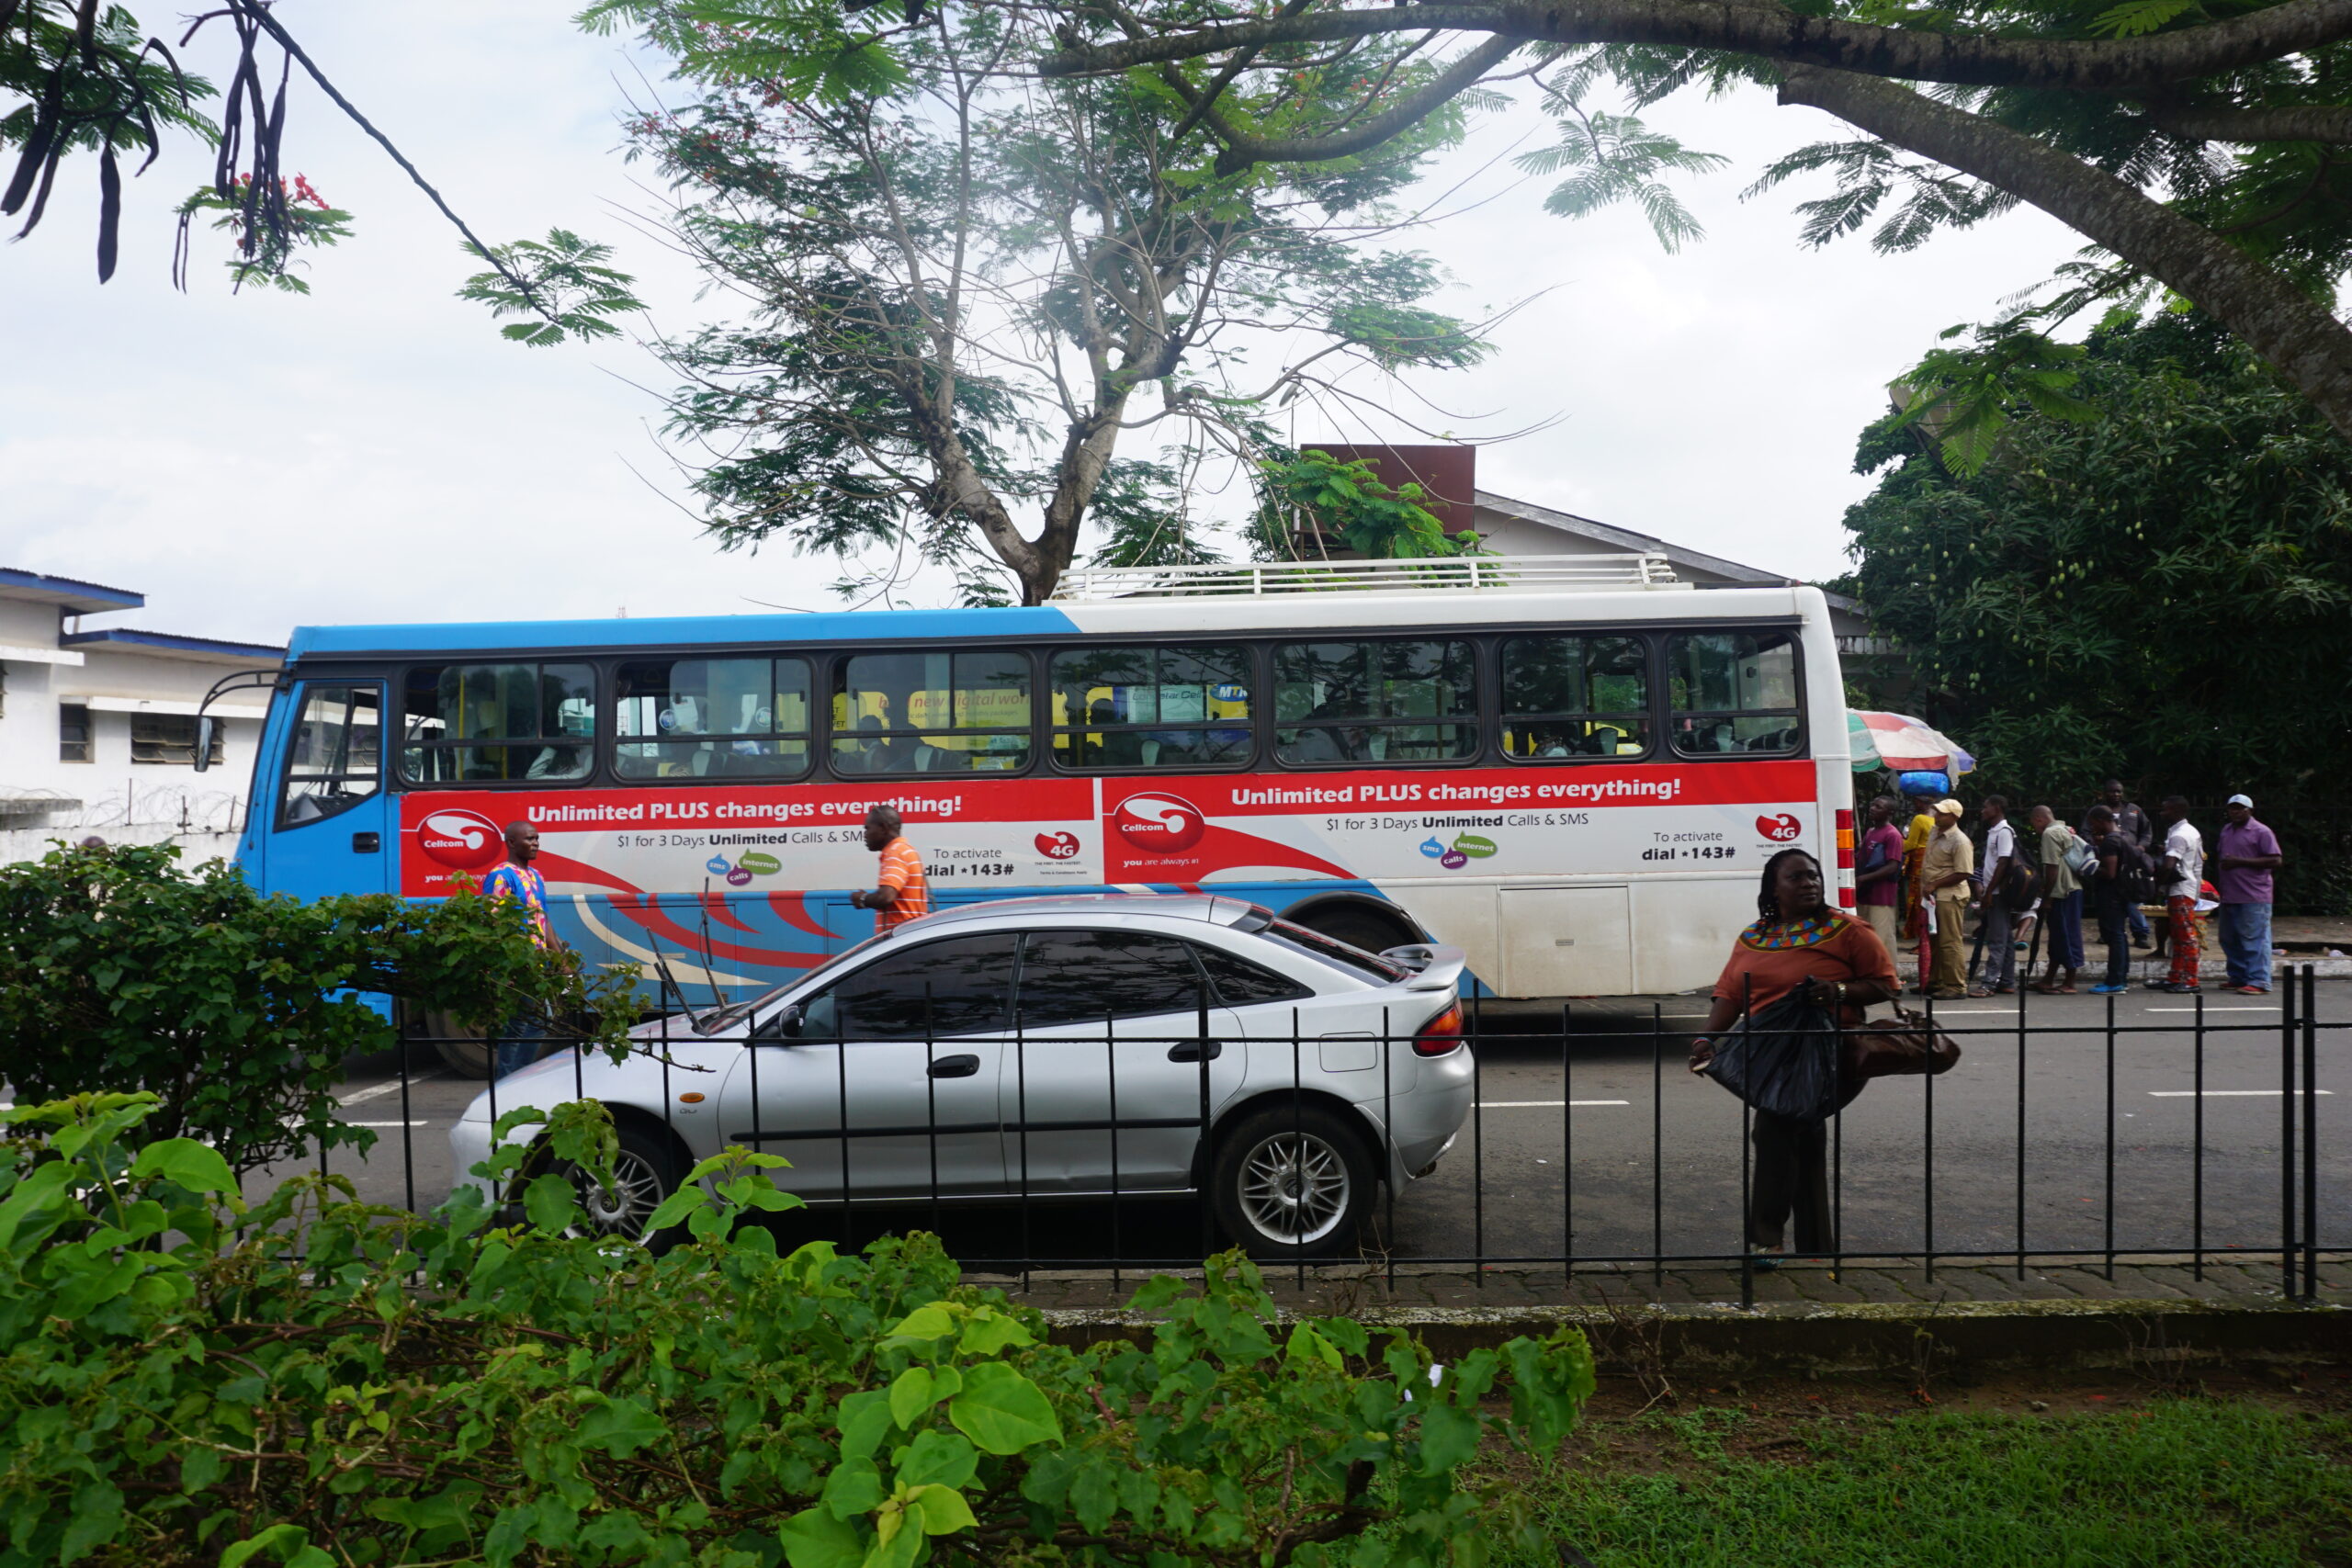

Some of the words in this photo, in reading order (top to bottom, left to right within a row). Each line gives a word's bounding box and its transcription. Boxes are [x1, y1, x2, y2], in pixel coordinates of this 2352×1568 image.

[914, 697, 944, 708] new
[1231, 786, 1352, 806] Unlimited
[1360, 784, 1421, 802] PLUS
[1428, 784, 1531, 804] changes
[1537, 779, 1680, 802] everything!
[527, 803, 644, 822] Unlimited
[650, 802, 709, 819] PLUS
[715, 800, 815, 822] changes
[1327, 818, 1339, 830] $1
[1345, 818, 1365, 829] for
[1369, 818, 1378, 829] 3
[1383, 818, 1418, 831] Days
[1422, 815, 1503, 828] Unlimited
[1508, 814, 1540, 827] Calls
[1544, 814, 1555, 826] &
[1560, 813, 1589, 826] SMS
[1653, 832, 1669, 842] To
[1673, 831, 1723, 842] activate
[1771, 827, 1795, 839] 4G
[424, 840, 464, 848] Cellcom
[617, 835, 629, 848] $1
[635, 835, 655, 847] for
[659, 835, 667, 847] 3
[672, 835, 705, 849] Days
[708, 832, 787, 845] Unlimited
[792, 830, 823, 843] Calls
[827, 831, 838, 842] &
[1050, 845, 1074, 856] 4G
[1456, 841, 1494, 852] internet
[933, 849, 949, 859] To
[953, 848, 1002, 859] activate
[1642, 848, 1676, 860] dial
[742, 858, 779, 869] internet
[1123, 858, 1142, 867] you
[1160, 857, 1190, 866] always
[1443, 855, 1464, 864] calls
[709, 862, 726, 870] sms
[924, 864, 955, 876] dial
[425, 874, 443, 883] you
[729, 872, 749, 881] calls
